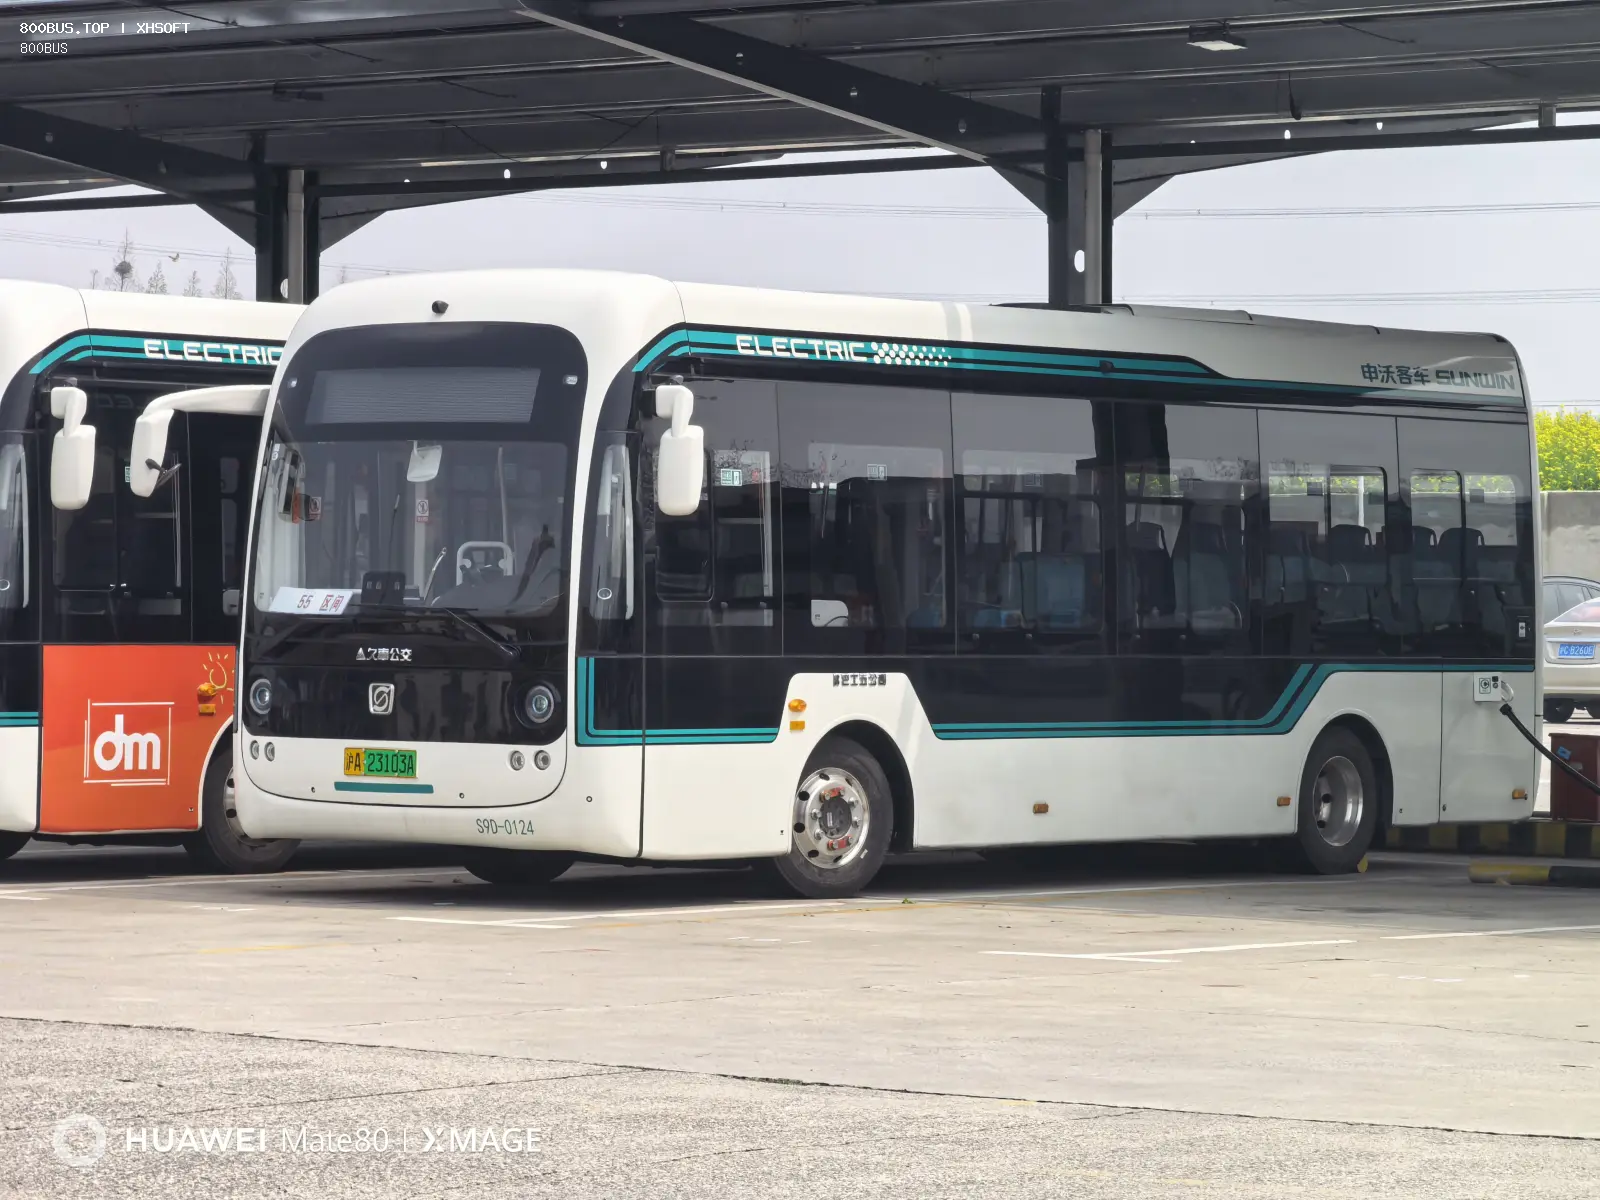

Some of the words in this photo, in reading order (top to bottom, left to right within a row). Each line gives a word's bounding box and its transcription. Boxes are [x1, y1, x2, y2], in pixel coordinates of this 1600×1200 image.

[143, 338, 284, 366] ELECTRIC
[736, 334, 868, 362] ELECTRIC
[1360, 362, 1431, 386] 申沃客车
[1435, 369, 1516, 390] SUNWIN
[297, 594, 314, 609] 55
[319, 594, 345, 612] 区间
[475, 818, 535, 836] S9D-0124
